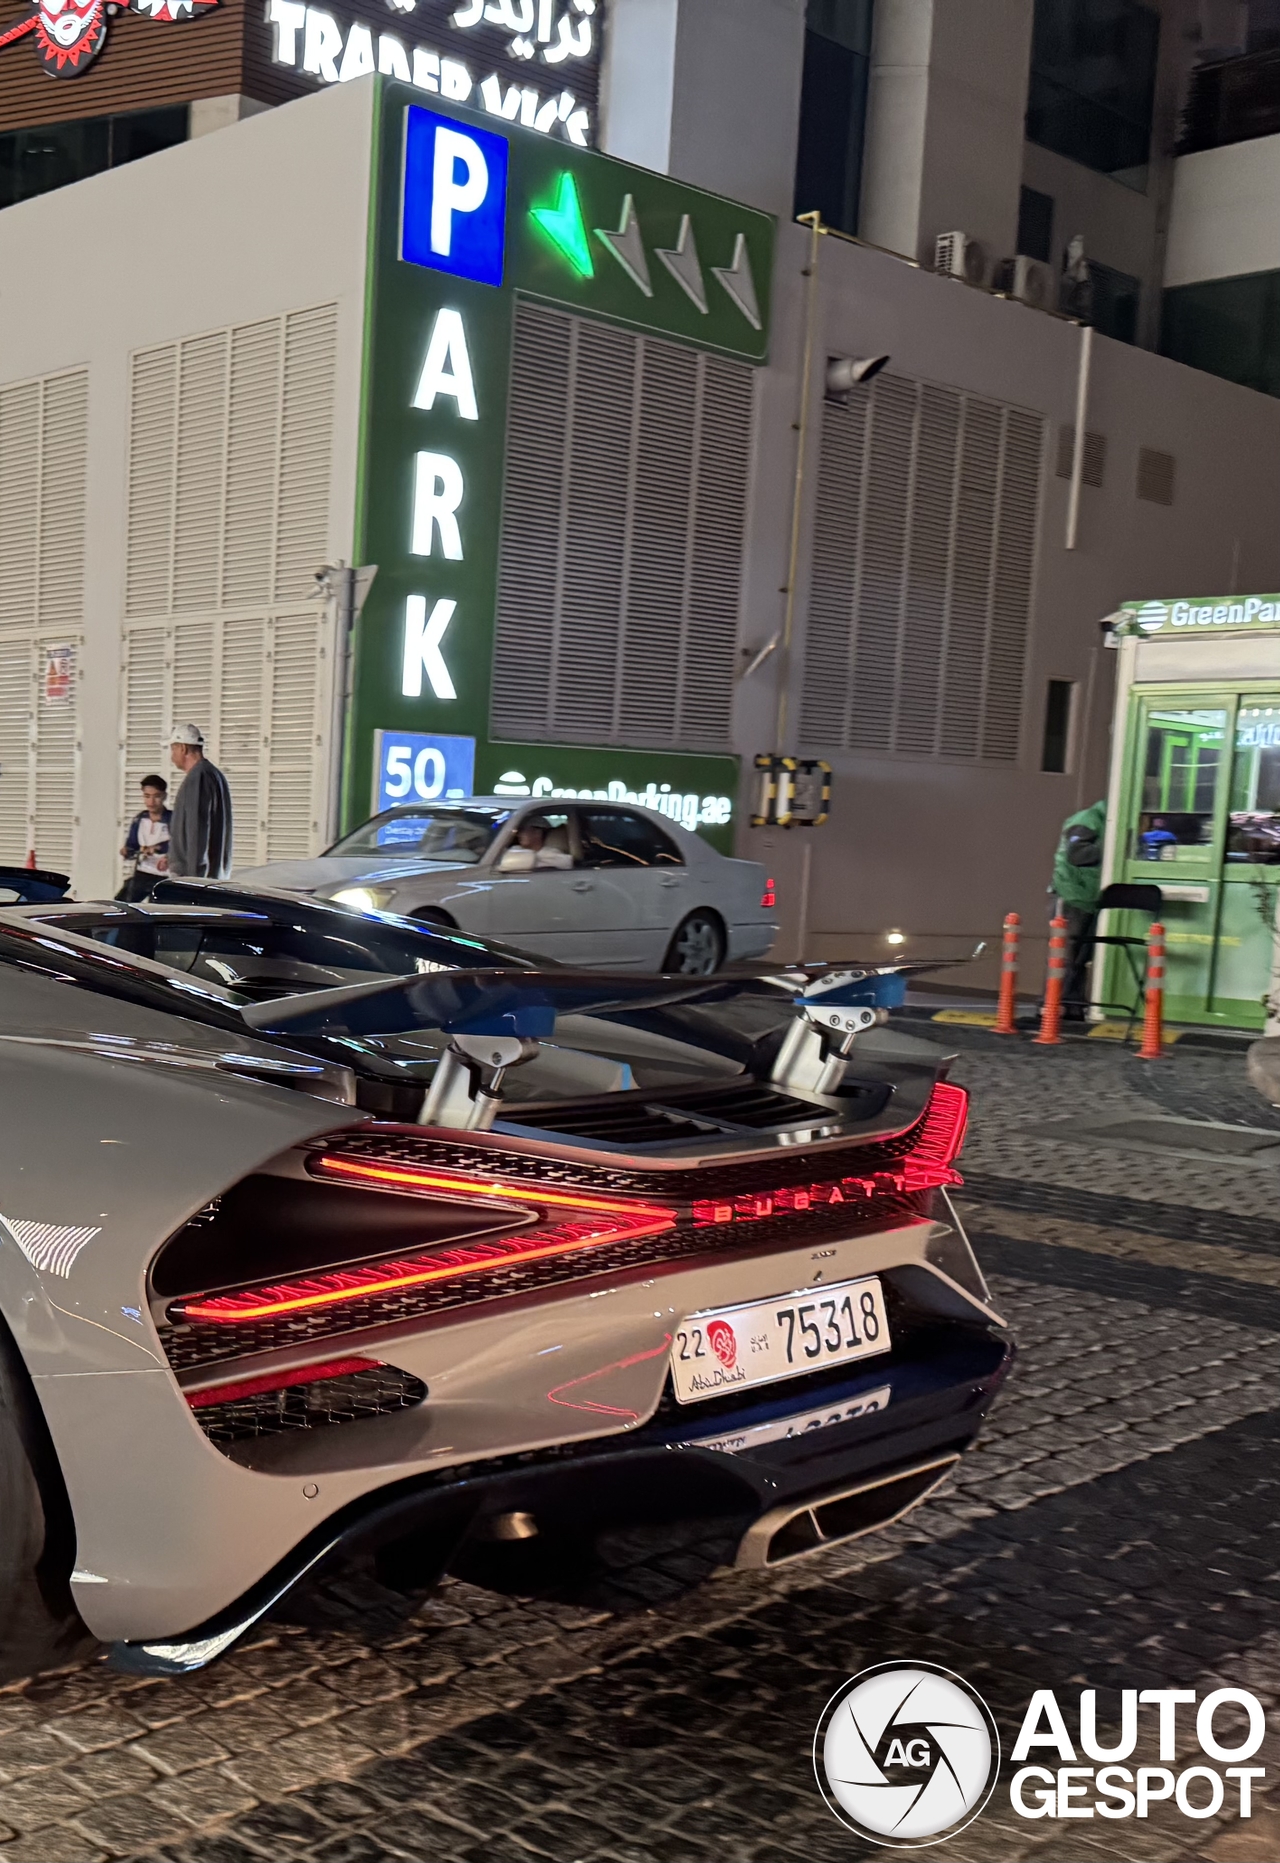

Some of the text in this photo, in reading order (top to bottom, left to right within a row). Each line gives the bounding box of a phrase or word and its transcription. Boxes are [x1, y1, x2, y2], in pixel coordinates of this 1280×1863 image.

[385, 746, 446, 799] 50
[677, 1291, 880, 1364] 22 75318
